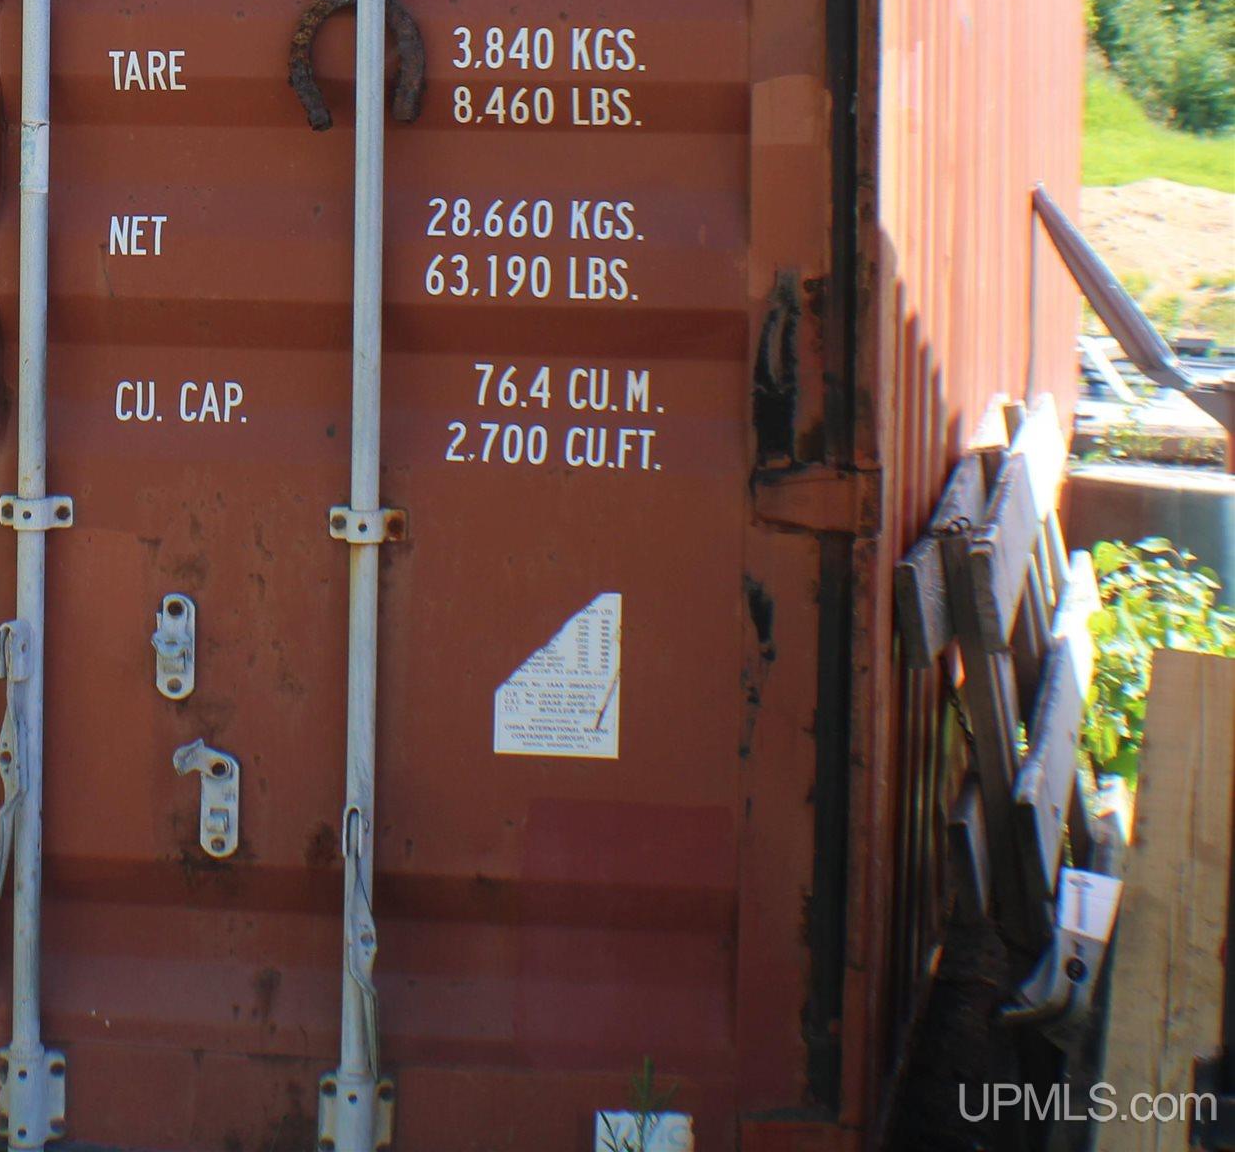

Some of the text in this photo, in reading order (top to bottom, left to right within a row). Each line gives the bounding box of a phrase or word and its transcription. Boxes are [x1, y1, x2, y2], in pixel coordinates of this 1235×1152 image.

[108, 50, 187, 91] TARE
[452, 27, 647, 72] 3,840 KGS.
[452, 86, 643, 128] 8,460 LBS.
[108, 216, 168, 257] NET
[426, 198, 645, 241] 28,660 KGS.
[424, 254, 640, 301] 63,190 LBS.
[114, 382, 248, 424] CU. CAP.
[474, 363, 552, 408] 76.4
[565, 426, 663, 471] CU.FT.
